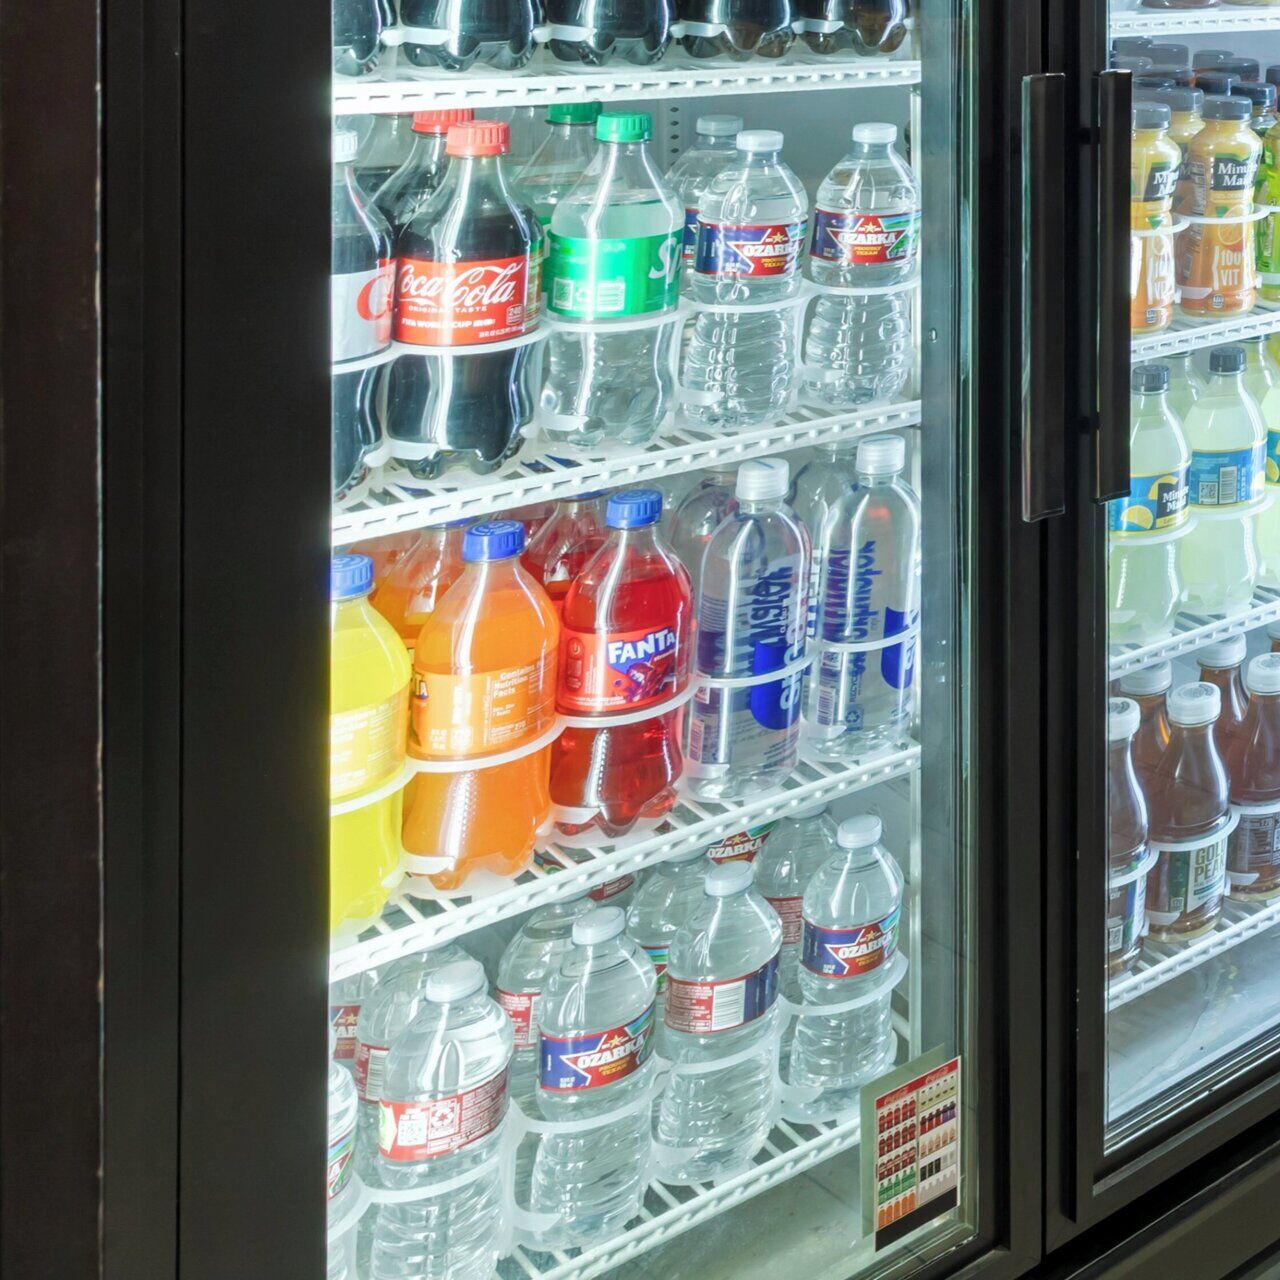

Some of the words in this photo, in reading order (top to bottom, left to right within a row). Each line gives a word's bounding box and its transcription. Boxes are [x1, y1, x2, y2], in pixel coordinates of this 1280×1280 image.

[838, 231, 897, 246] OZARKA
[399, 261, 524, 307] Coca-Cola
[607, 628, 676, 664] FANTA
[706, 837, 764, 858] OZARKA
[577, 1033, 645, 1069] OZARKA
